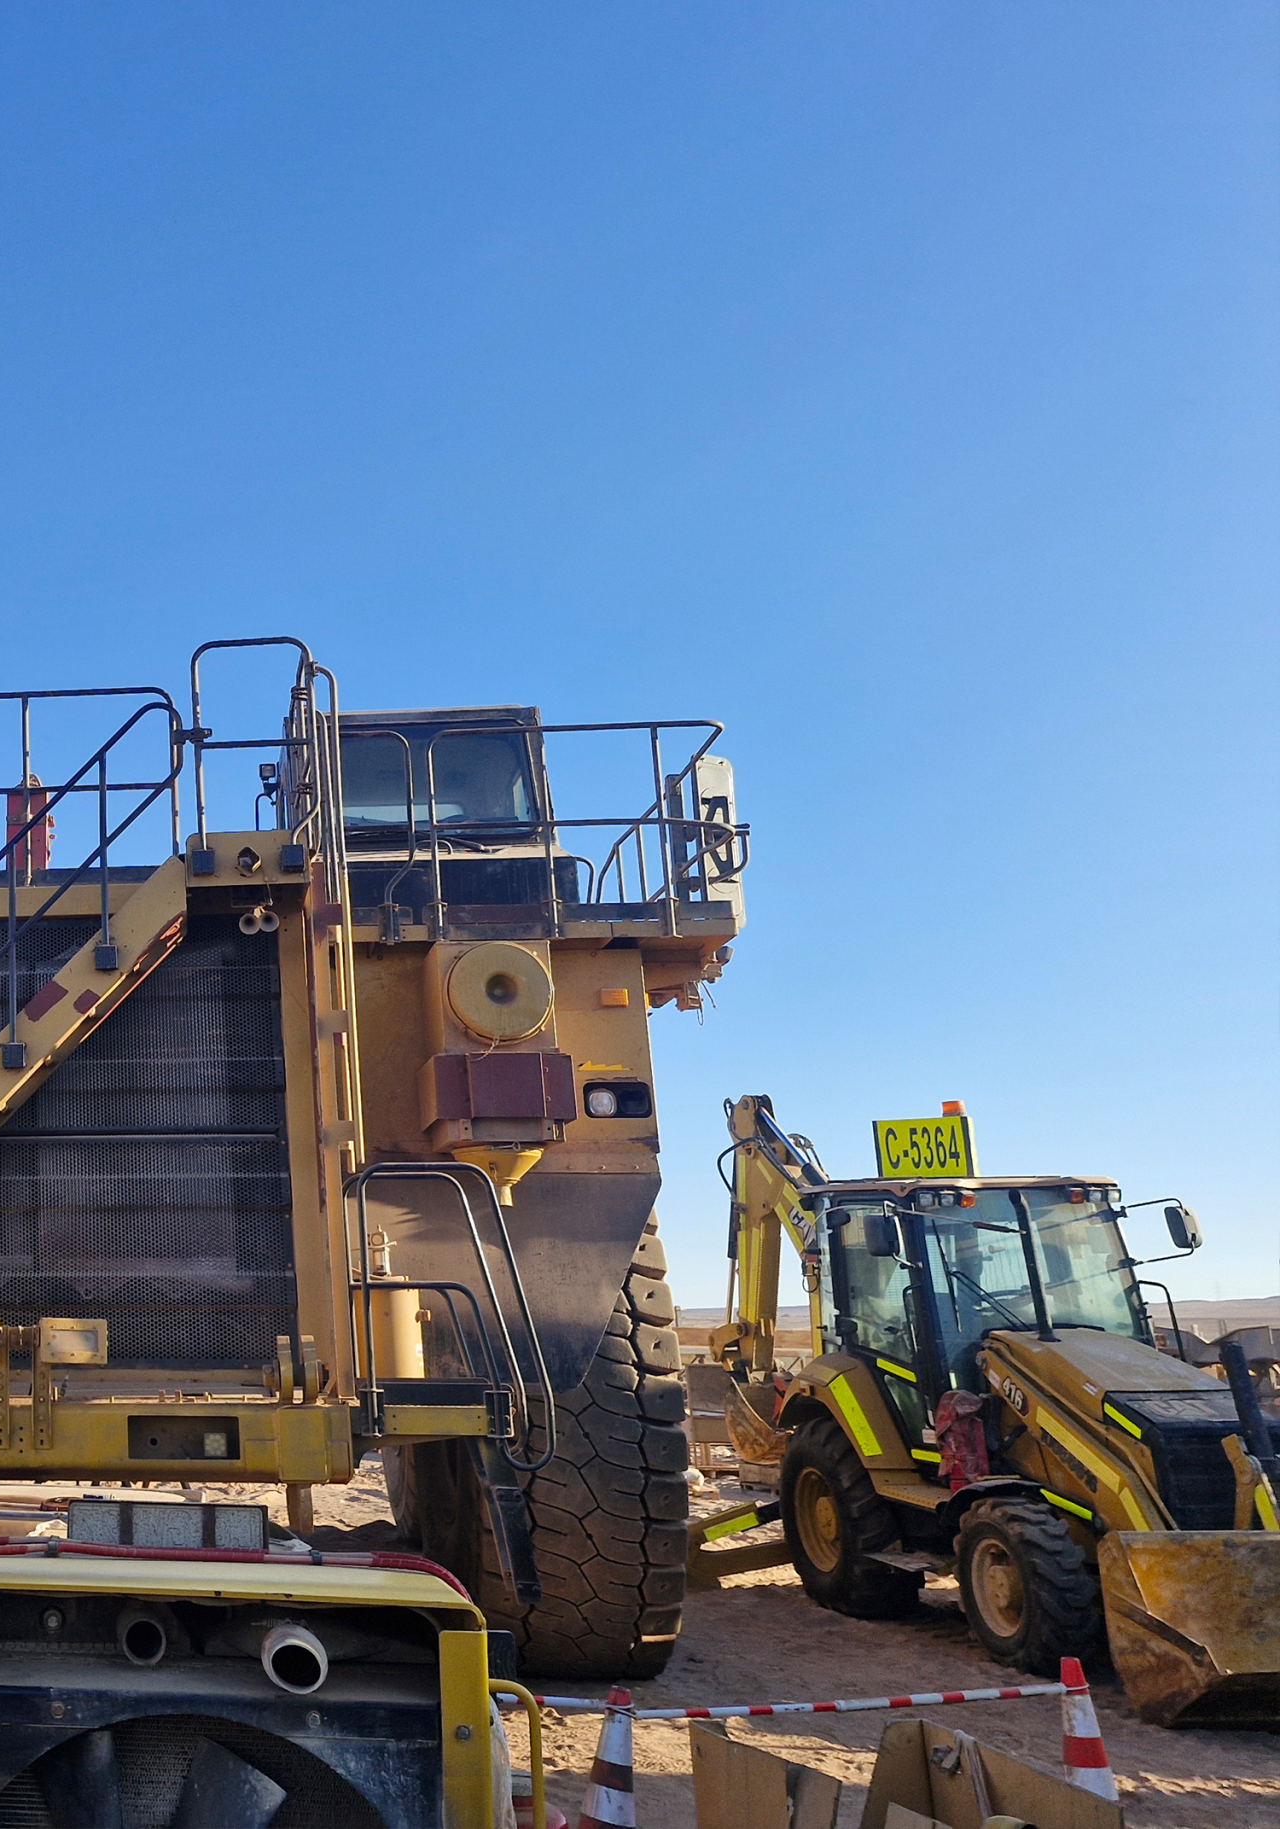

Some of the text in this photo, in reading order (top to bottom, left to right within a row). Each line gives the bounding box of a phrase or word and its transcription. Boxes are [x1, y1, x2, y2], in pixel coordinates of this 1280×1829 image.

[885, 1125, 960, 1170] C-5364
[1002, 1377, 1024, 1411] 416
[1144, 1399, 1218, 1417] CAT
